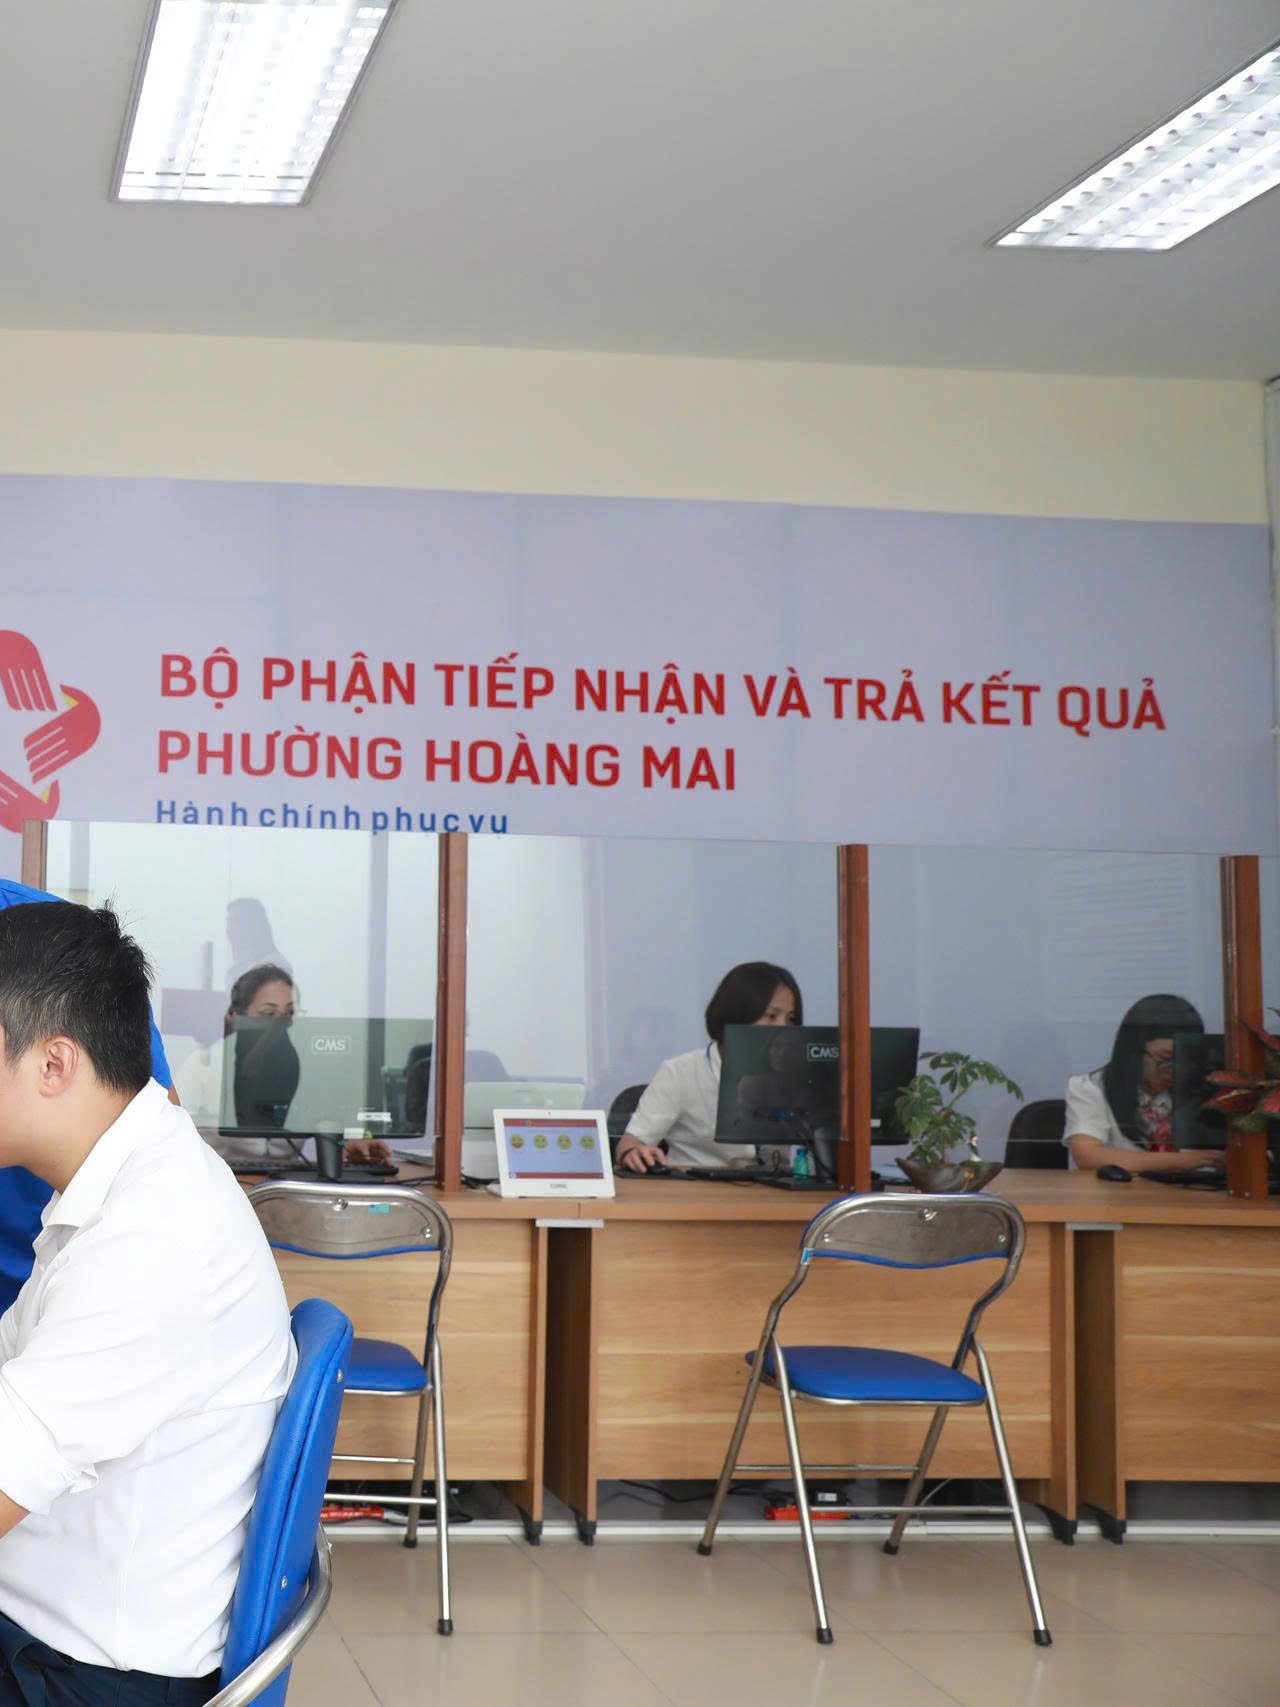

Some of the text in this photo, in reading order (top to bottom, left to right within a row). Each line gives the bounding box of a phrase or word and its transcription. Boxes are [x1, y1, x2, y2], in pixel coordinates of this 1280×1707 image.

[161, 647, 1166, 737] BỘ PHẬN TIẾP NHẬN VÀ TRẢ KẾT QUẢ
[159, 724, 736, 791] PHƯỜNG HOÀNG MAI
[156, 800, 250, 827] Hành
[258, 803, 364, 832] chính
[314, 1038, 347, 1051] CMS
[810, 1046, 840, 1059] CMS
